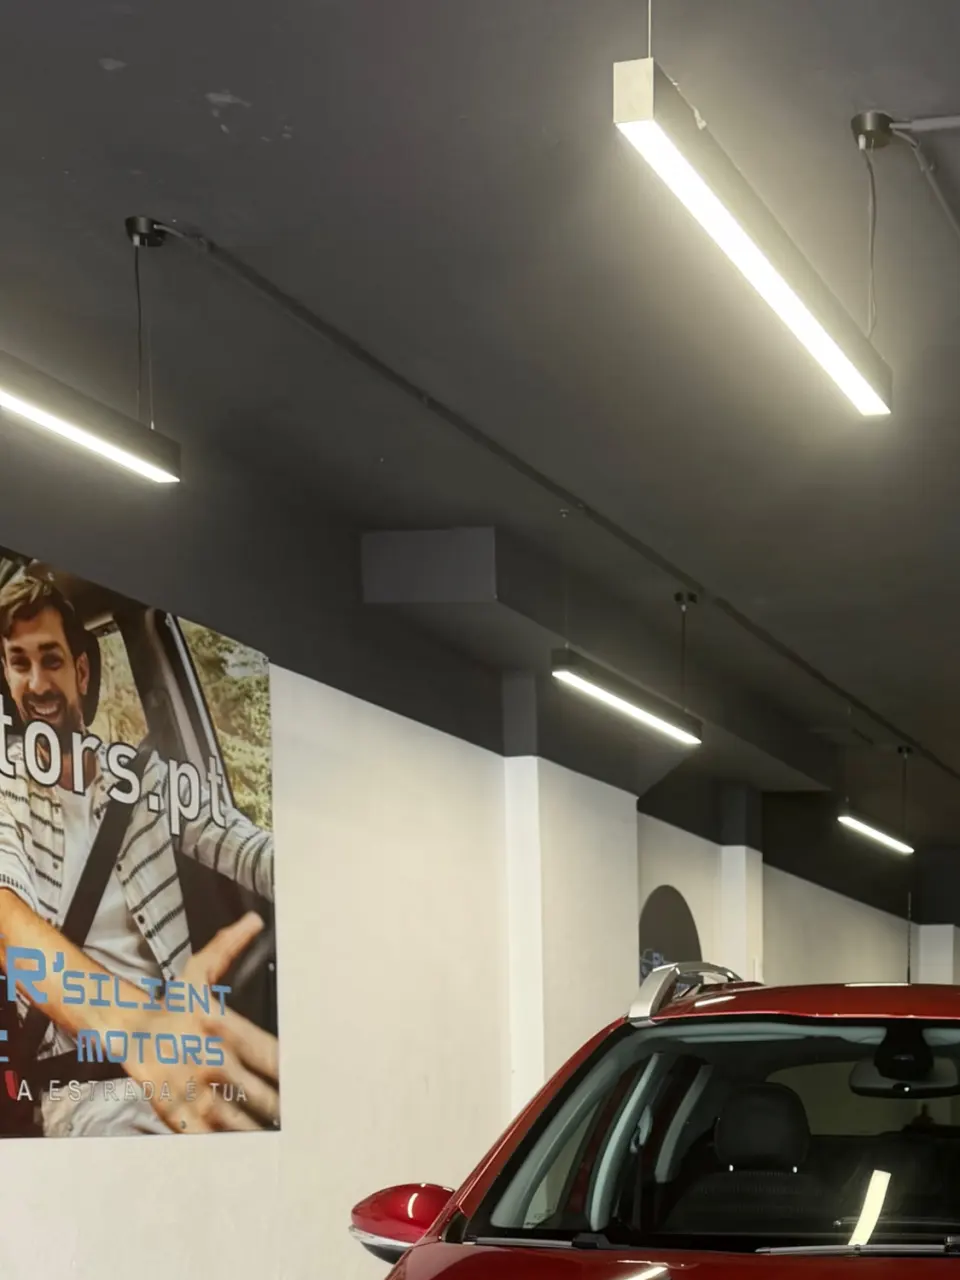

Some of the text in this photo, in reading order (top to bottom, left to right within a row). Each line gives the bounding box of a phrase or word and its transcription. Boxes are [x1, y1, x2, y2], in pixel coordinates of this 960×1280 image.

[6, 946, 232, 1016] R'SILIENT
[77, 1029, 225, 1067] MOTORS
[16, 1079, 33, 1101] A
[50, 1079, 171, 1102] ESTRADA
[211, 1082, 249, 1102] TUA
